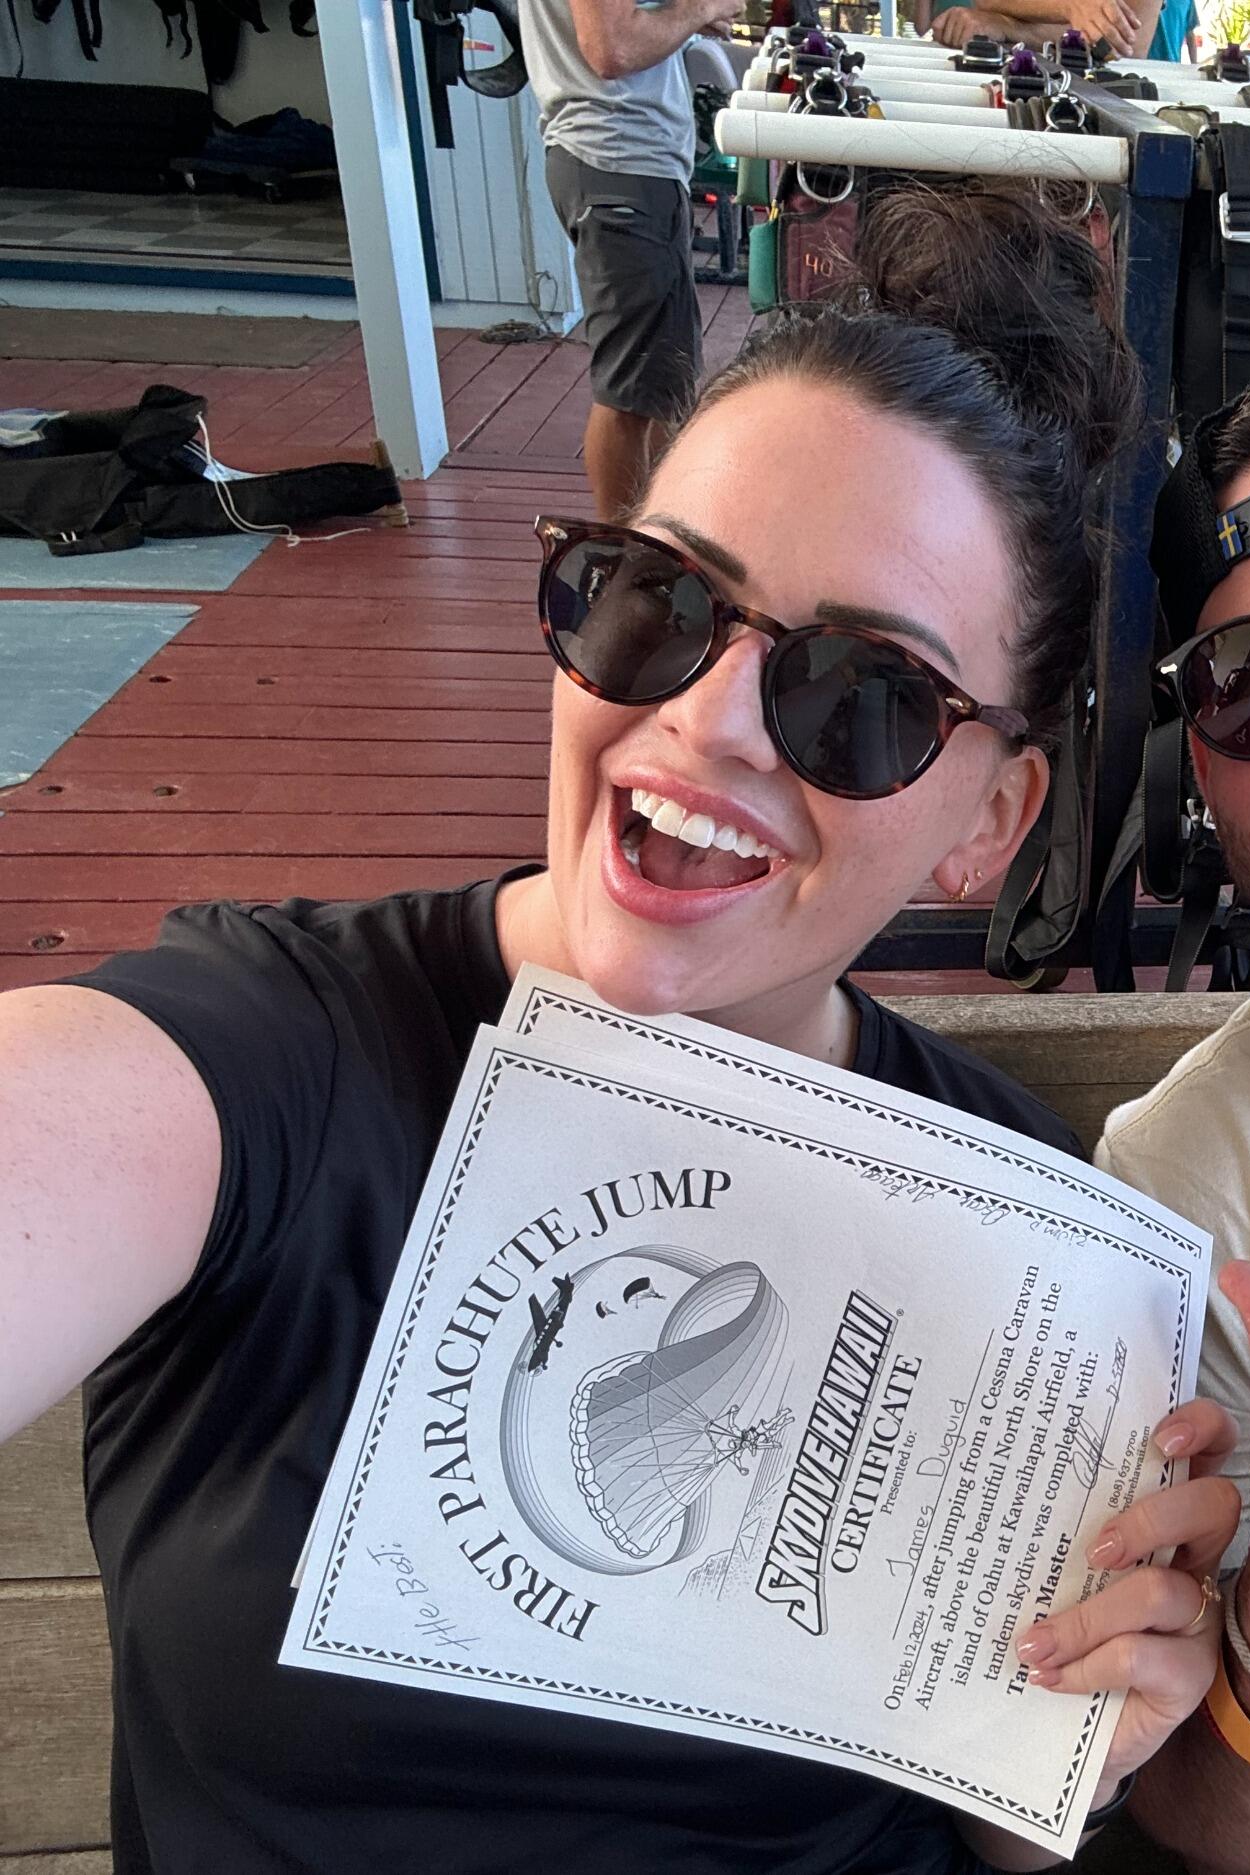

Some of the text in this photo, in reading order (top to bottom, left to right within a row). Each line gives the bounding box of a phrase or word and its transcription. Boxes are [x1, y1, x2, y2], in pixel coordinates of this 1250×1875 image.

[1003, 1266, 1039, 1341] Caravan
[424, 1168, 731, 1642] FIRST PARACHUTE JUMP
[981, 1347, 1015, 1410] Cessna
[960, 1431, 987, 1474] from
[980, 1416, 992, 1426] a
[824, 1354, 922, 1573] CERTIFICATE
[880, 1430, 917, 1515] Presented to:
[888, 1399, 967, 1577] James Duguid
[915, 1283, 1061, 1711] Aircraft, above the beautiful North Shore on the
[1108, 1430, 1138, 1508] (808) 637 9700
[934, 1477, 975, 1557] jumping
[950, 1331, 1077, 1686] island of Oahu at Kawaihapai Airfield, a
[983, 1614, 1018, 1680] tandem
[1007, 1543, 1040, 1610] skydive
[1032, 1503, 1052, 1537] was
[1045, 1404, 1084, 1500] completed
[1076, 1352, 1098, 1399] with:
[923, 1556, 946, 1599] after
[1035, 1533, 1075, 1608] Master
[884, 1685, 905, 1710] On
